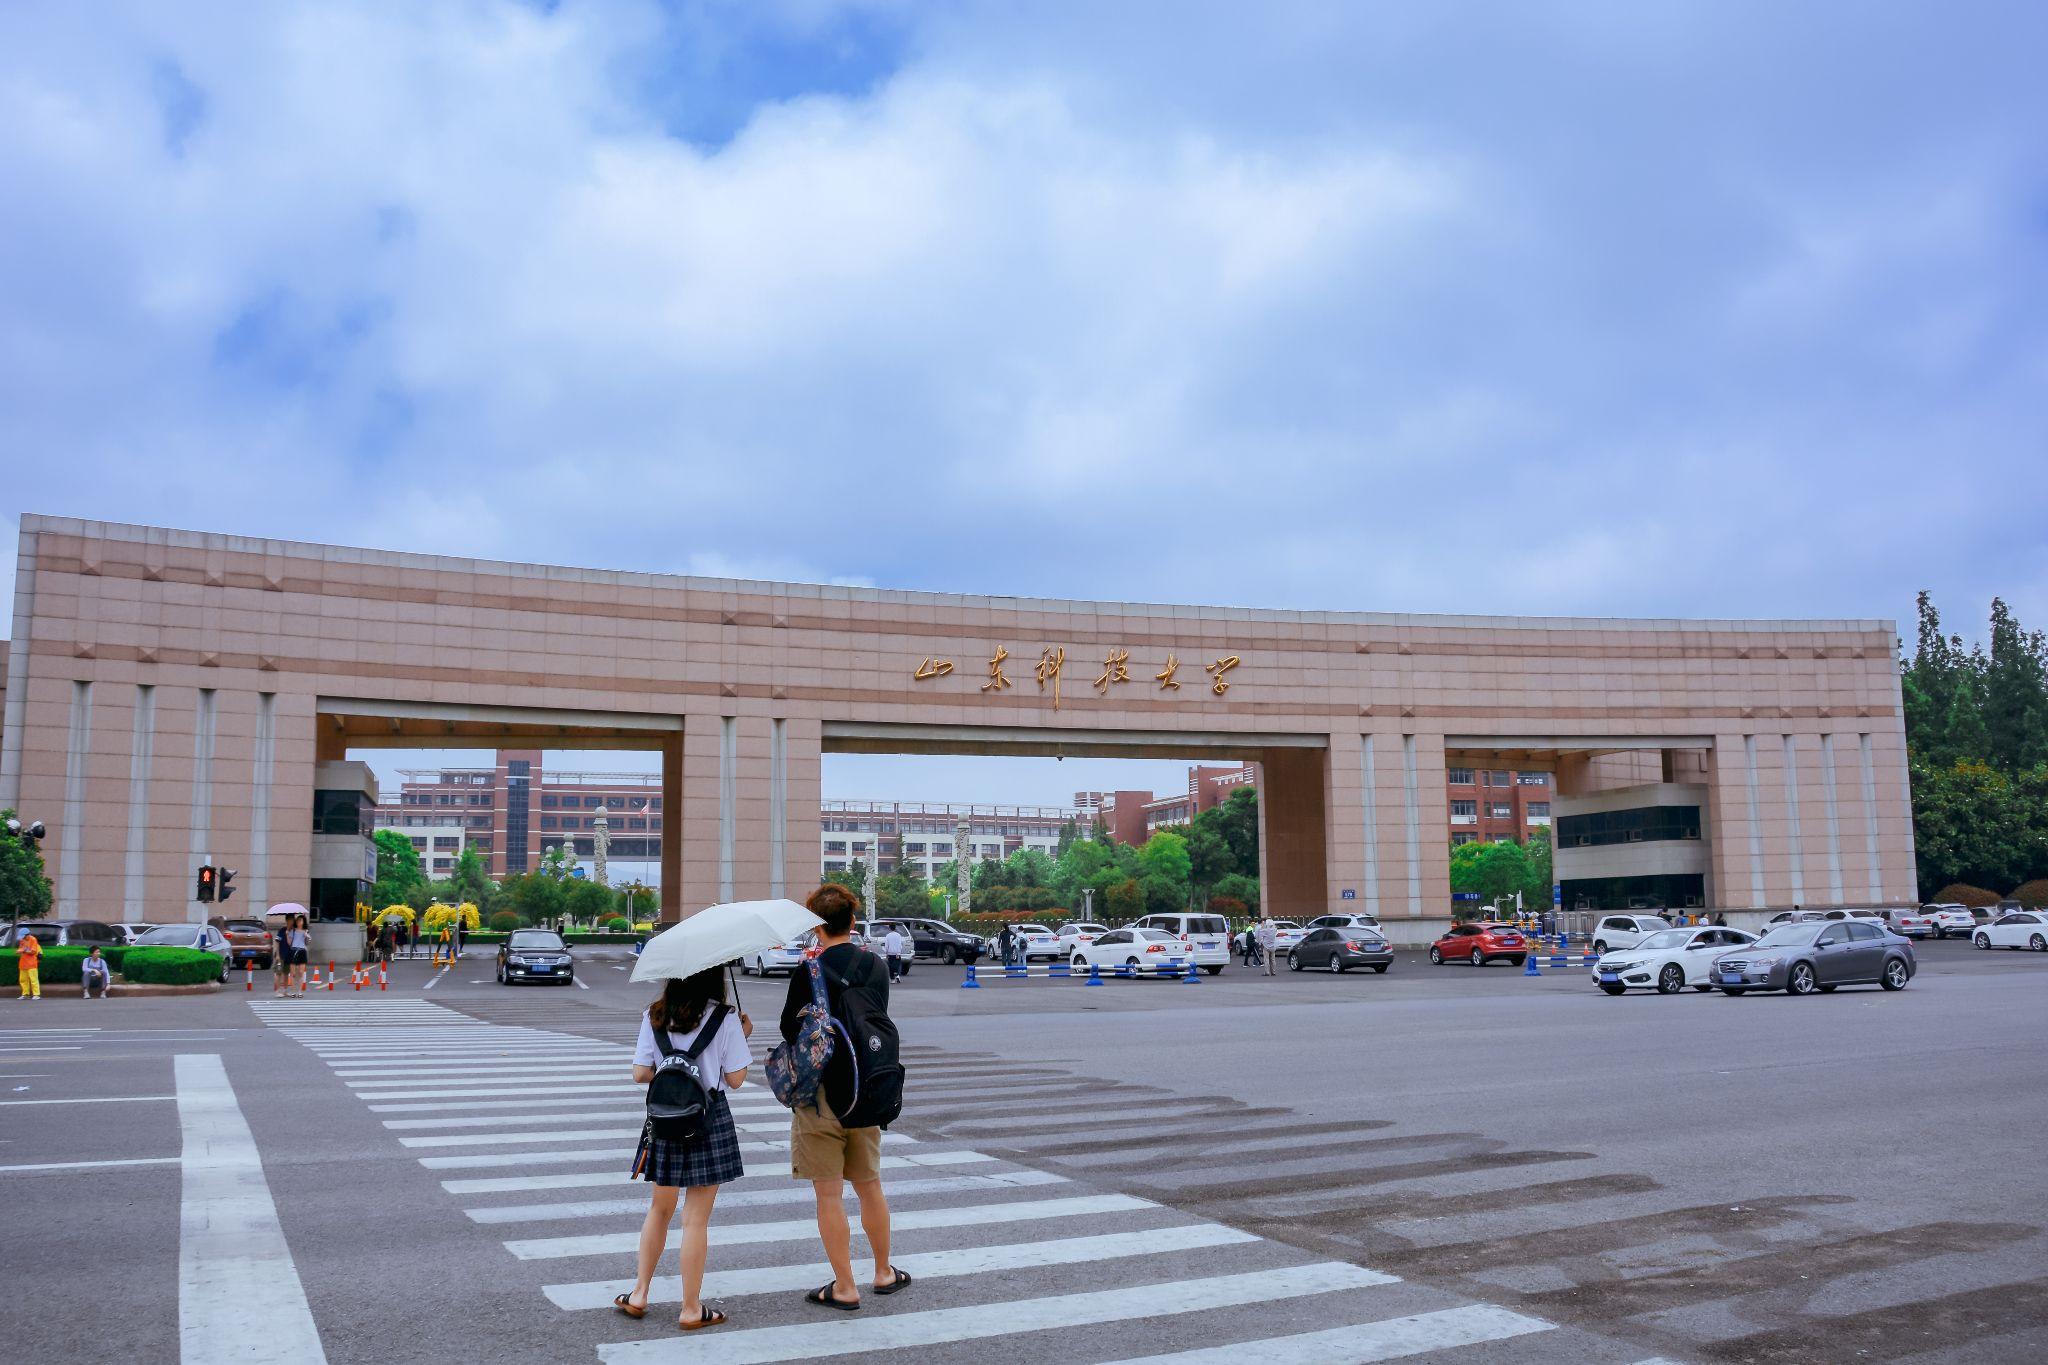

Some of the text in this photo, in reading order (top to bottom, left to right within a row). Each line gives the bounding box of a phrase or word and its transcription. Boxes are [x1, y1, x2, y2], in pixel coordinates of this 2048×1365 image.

[914, 644, 1240, 712] 山东科技大学
